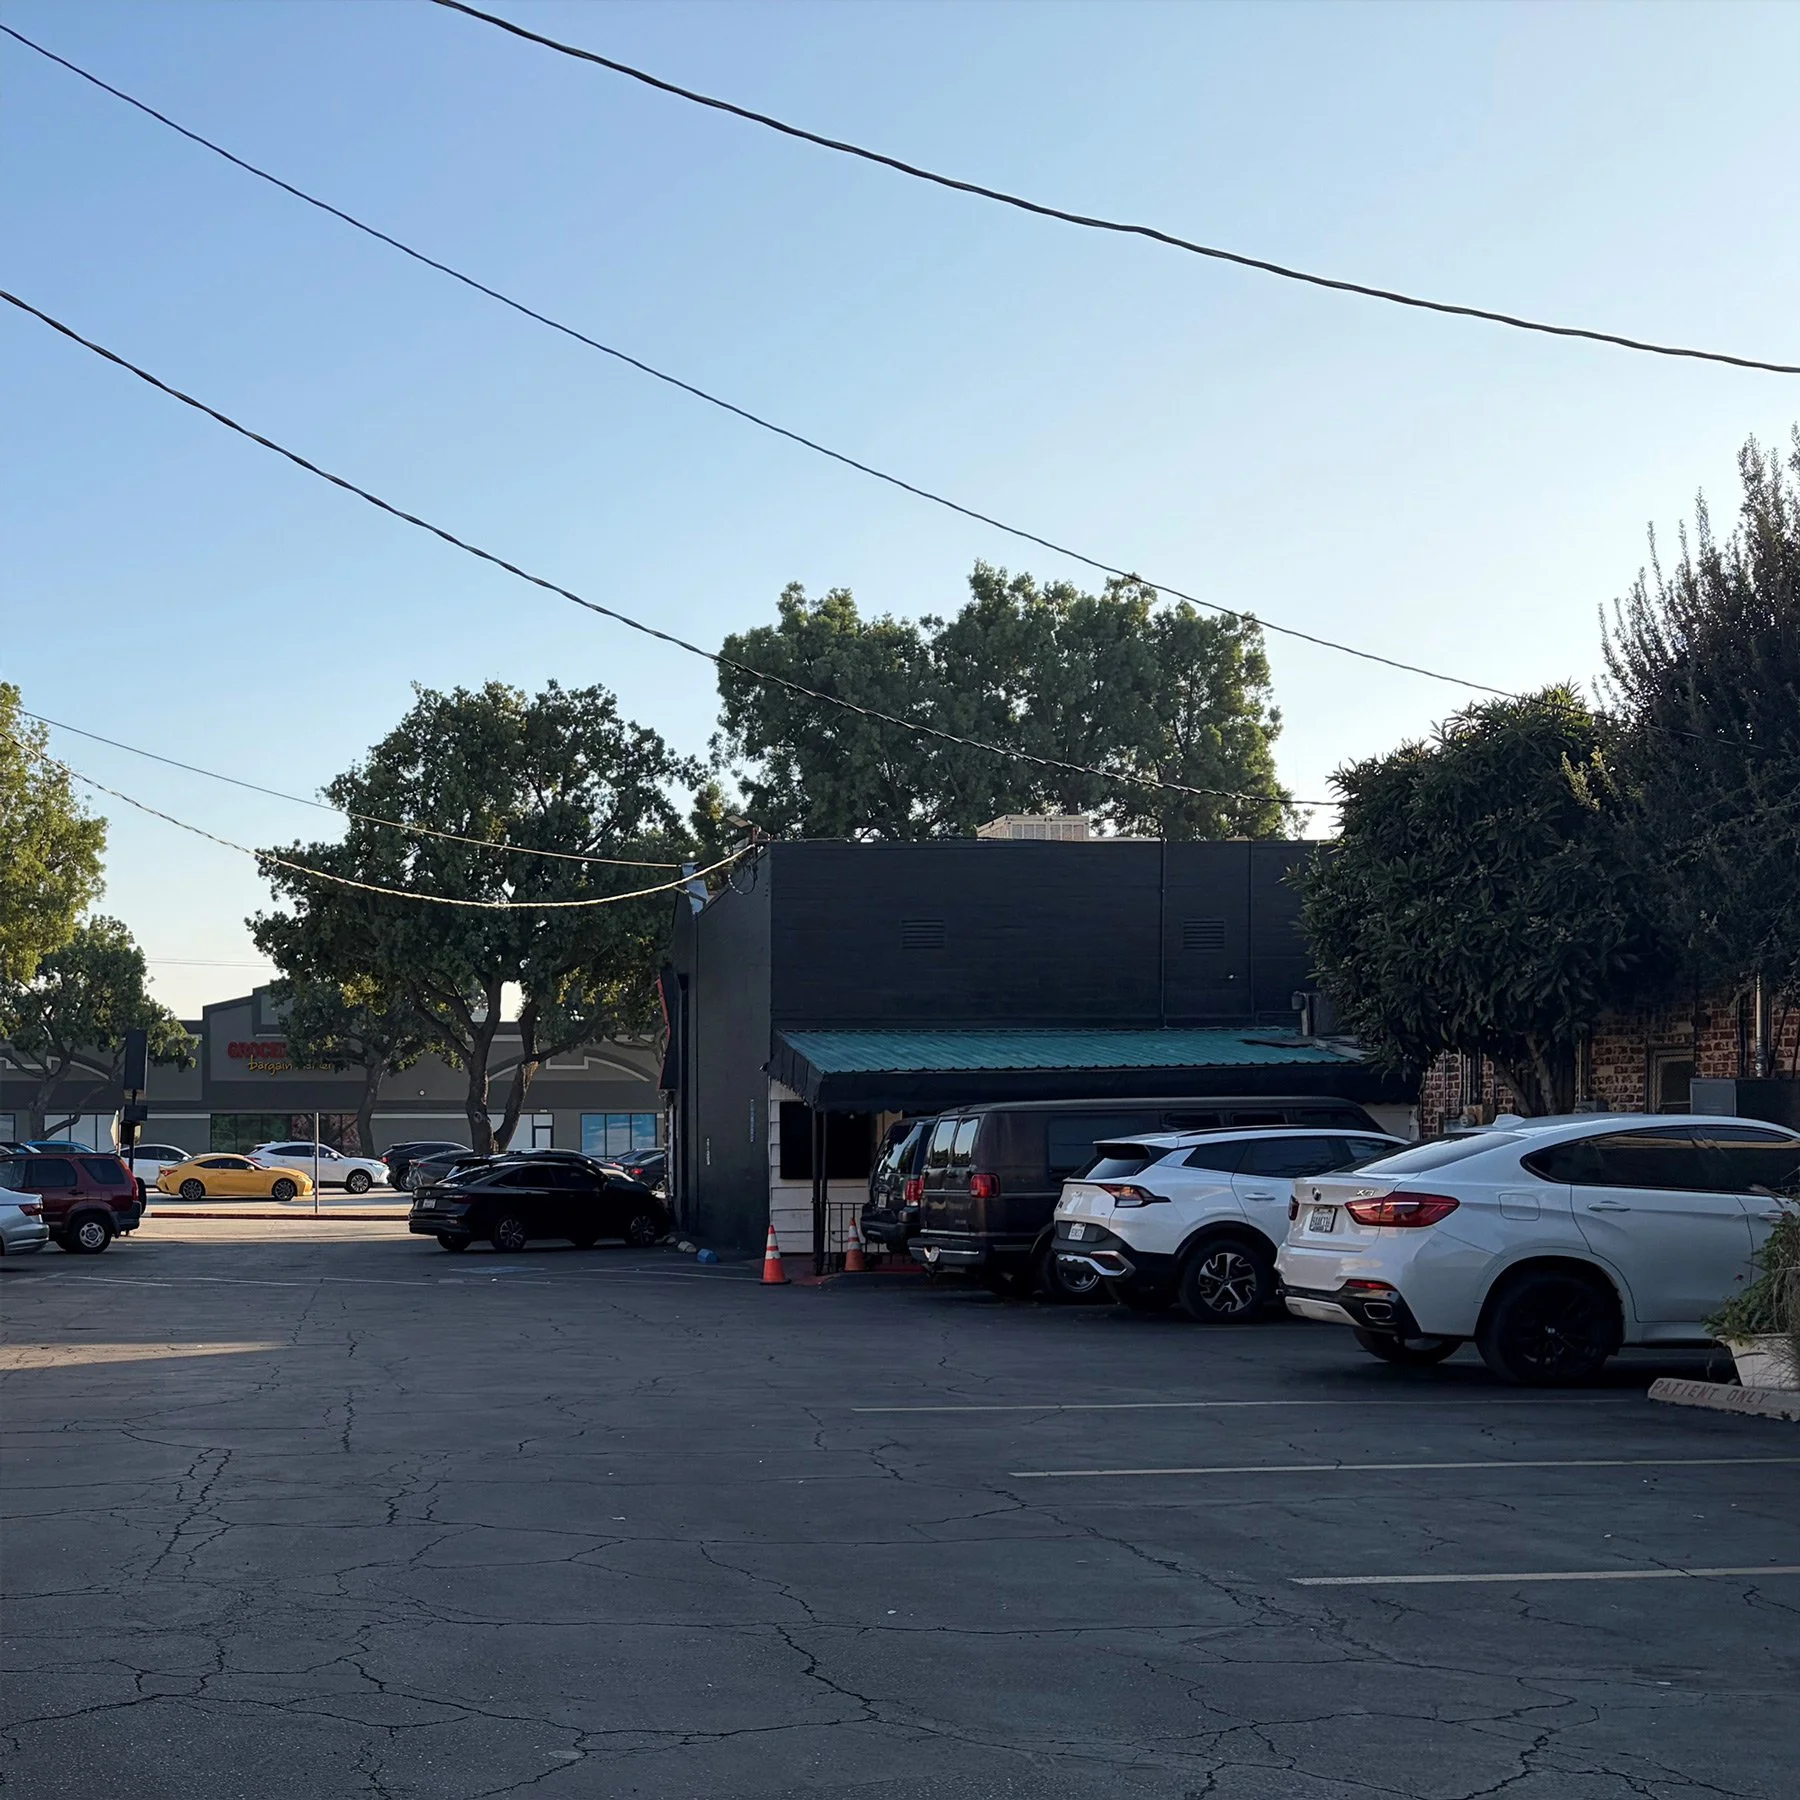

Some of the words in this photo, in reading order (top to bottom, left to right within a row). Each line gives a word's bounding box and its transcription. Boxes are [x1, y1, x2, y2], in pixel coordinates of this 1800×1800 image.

[248, 1054, 292, 1075] bargain
[1652, 1380, 1720, 1402] PATIENT
[1726, 1389, 1770, 1404] ONLY
